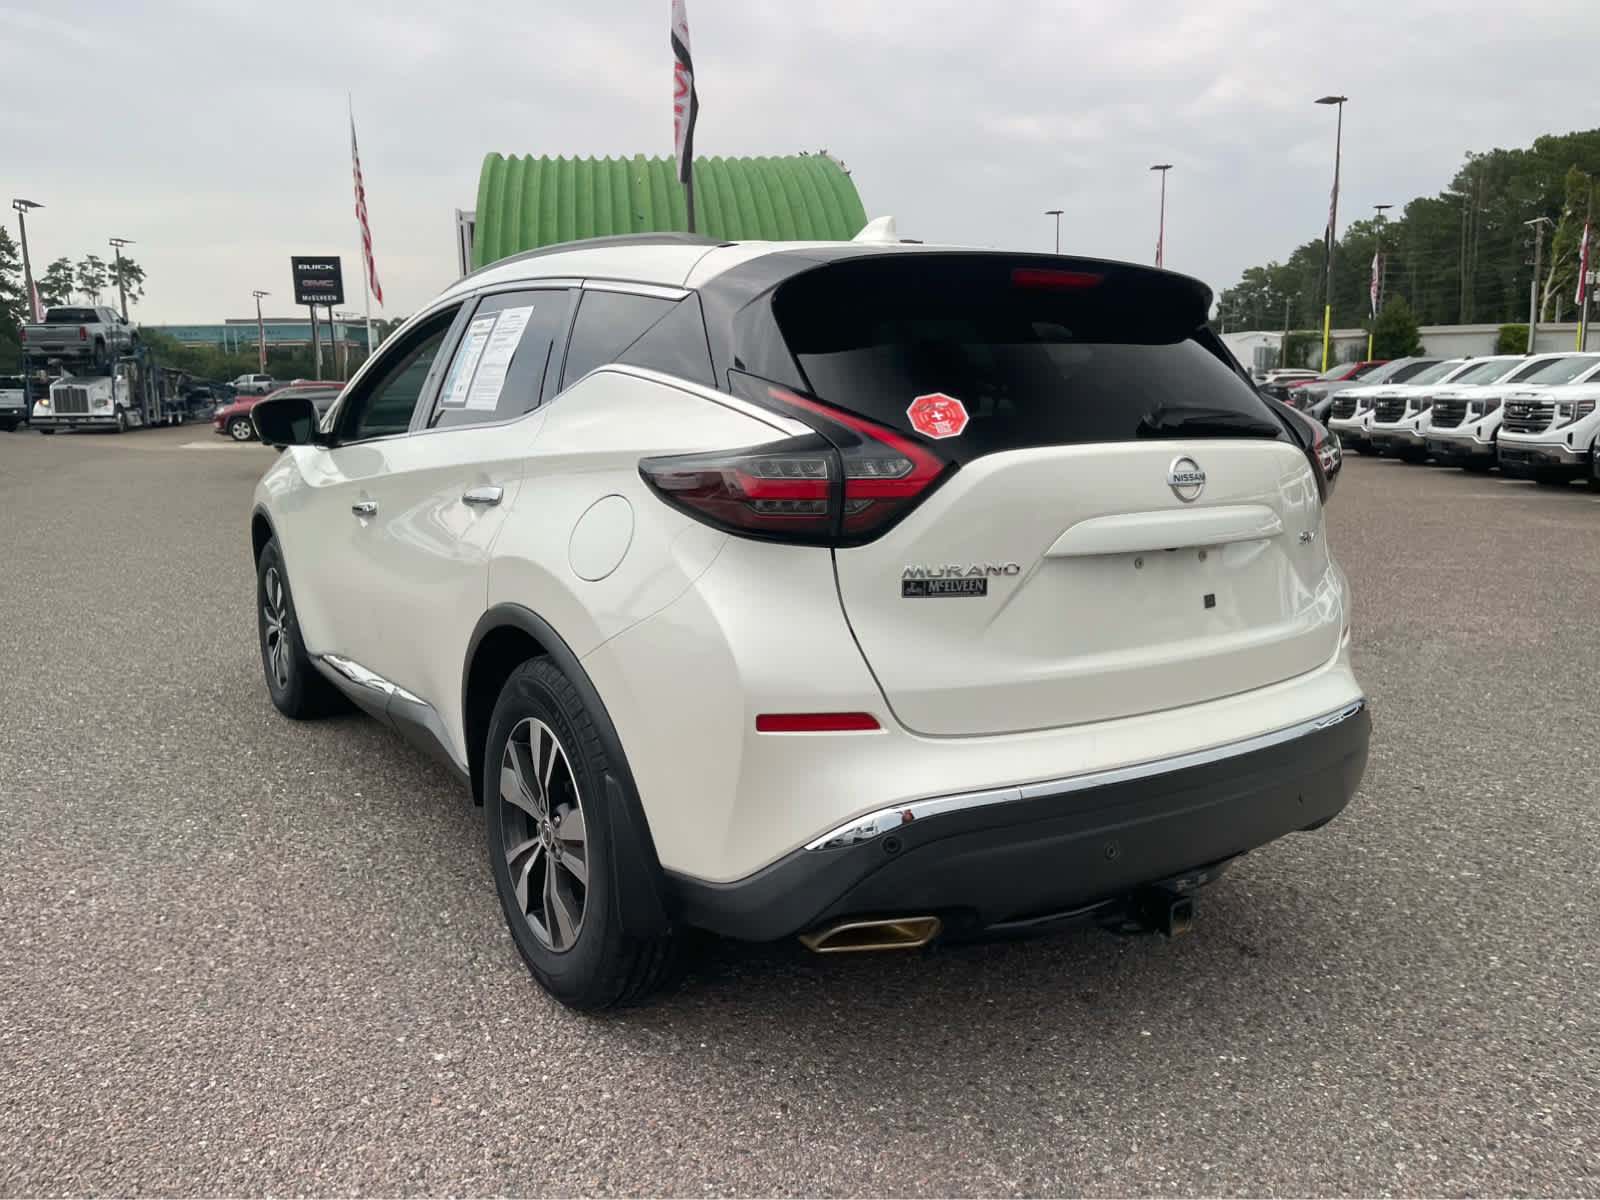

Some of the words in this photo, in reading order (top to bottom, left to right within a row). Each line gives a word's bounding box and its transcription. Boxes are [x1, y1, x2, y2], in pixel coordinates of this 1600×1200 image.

[302, 279, 335, 287] GMC
[1173, 472, 1205, 482] NISSAN
[902, 562, 1020, 579] MURANO
